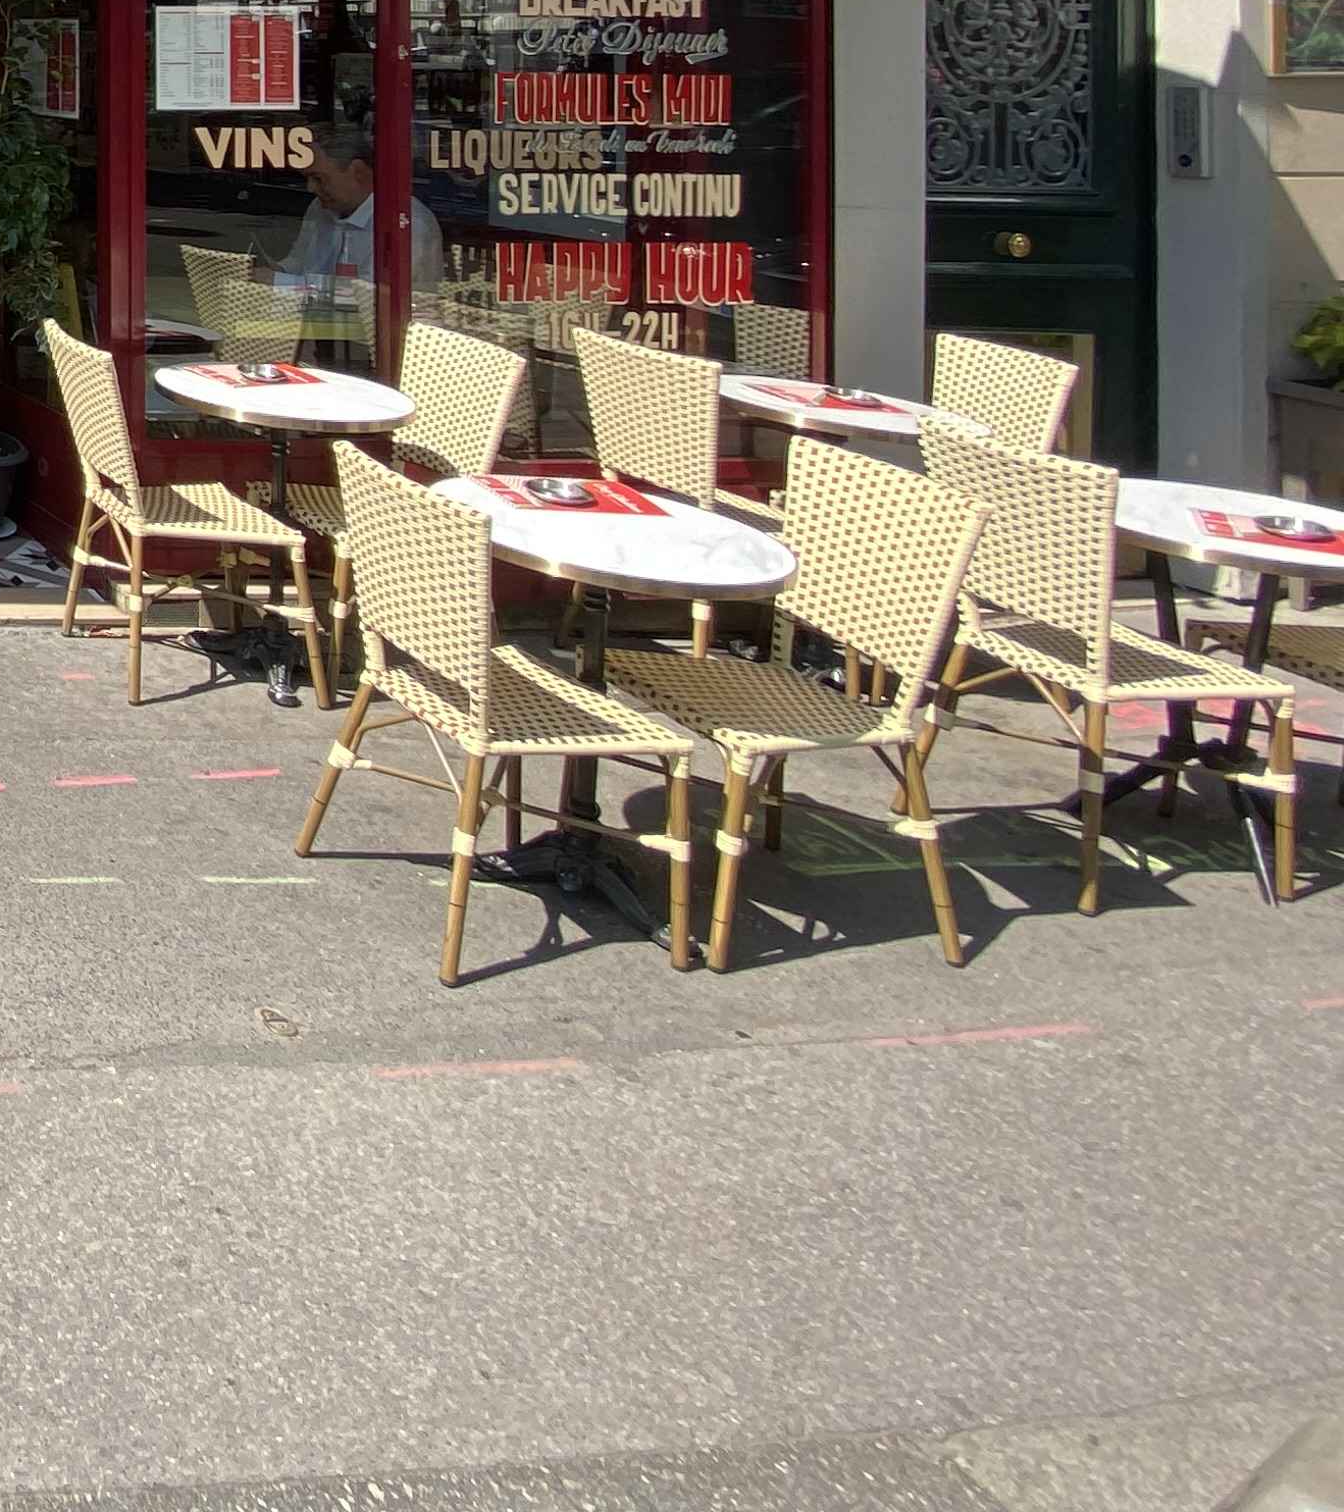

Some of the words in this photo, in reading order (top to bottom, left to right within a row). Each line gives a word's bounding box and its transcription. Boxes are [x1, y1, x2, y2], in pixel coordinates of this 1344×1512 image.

[494, 72, 652, 126] FORMULES
[662, 74, 732, 126] MIDI
[195, 127, 315, 169] VINS
[430, 130, 603, 175] LIQUEURS
[498, 174, 628, 216] SERVICE
[634, 174, 741, 217] CONTINU
[495, 242, 632, 305] HAPPY
[646, 242, 754, 306] HOUR
